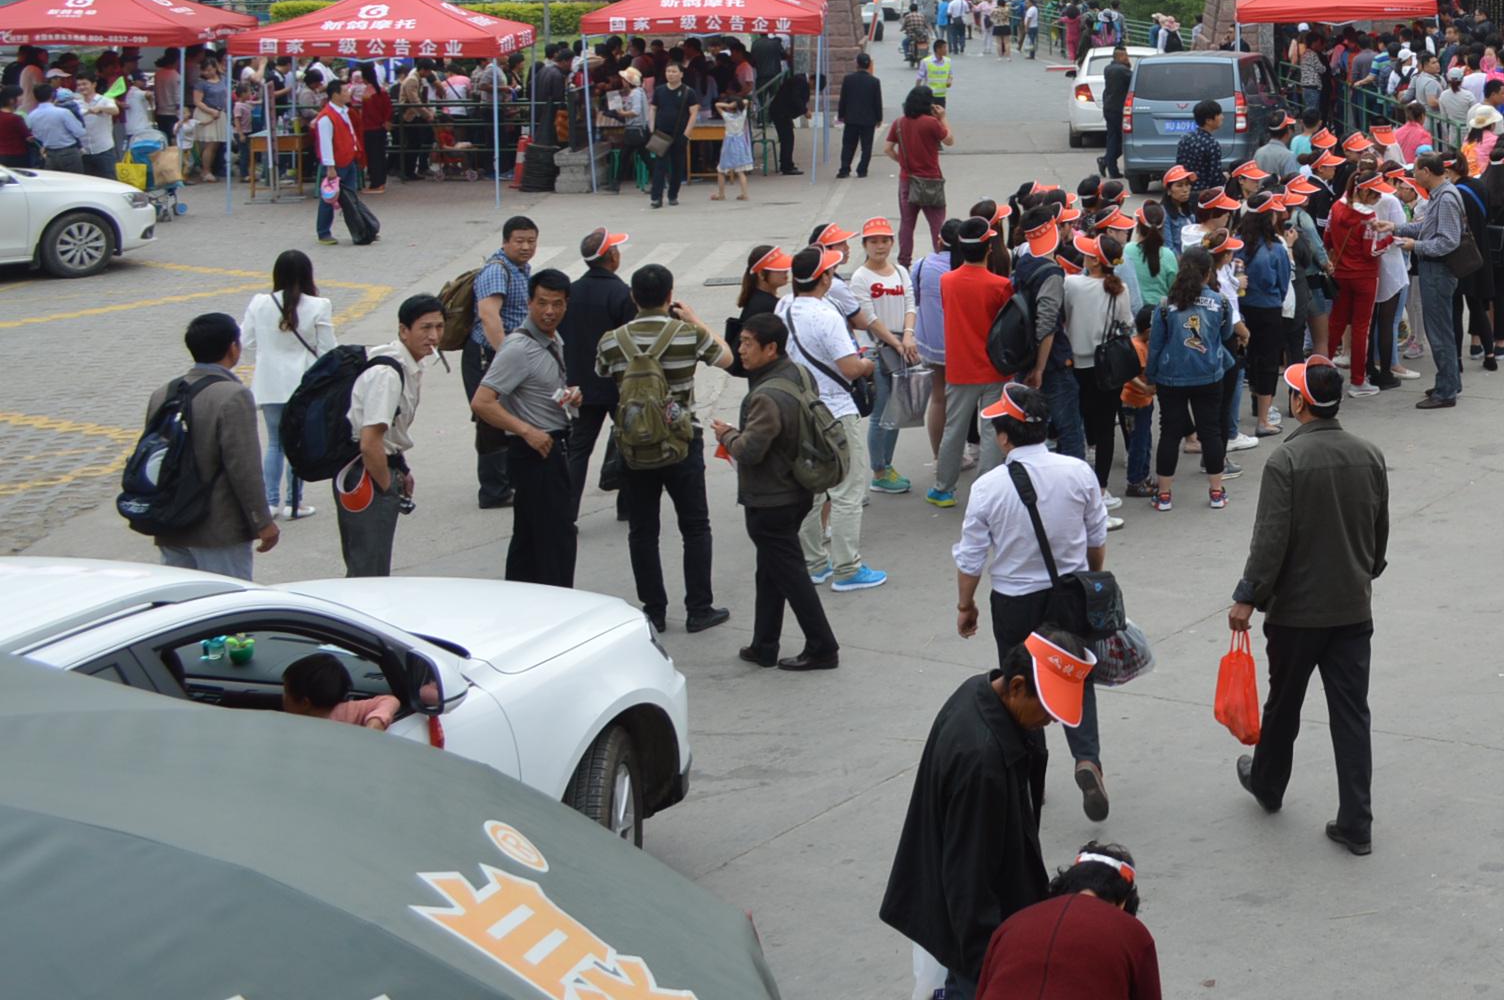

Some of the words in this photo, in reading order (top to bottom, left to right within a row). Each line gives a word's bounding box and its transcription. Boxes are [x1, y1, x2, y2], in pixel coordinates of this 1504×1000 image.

[609, 15, 793, 33] 国家一级公告企业
[259, 37, 463, 56] 国家一级公告企业
